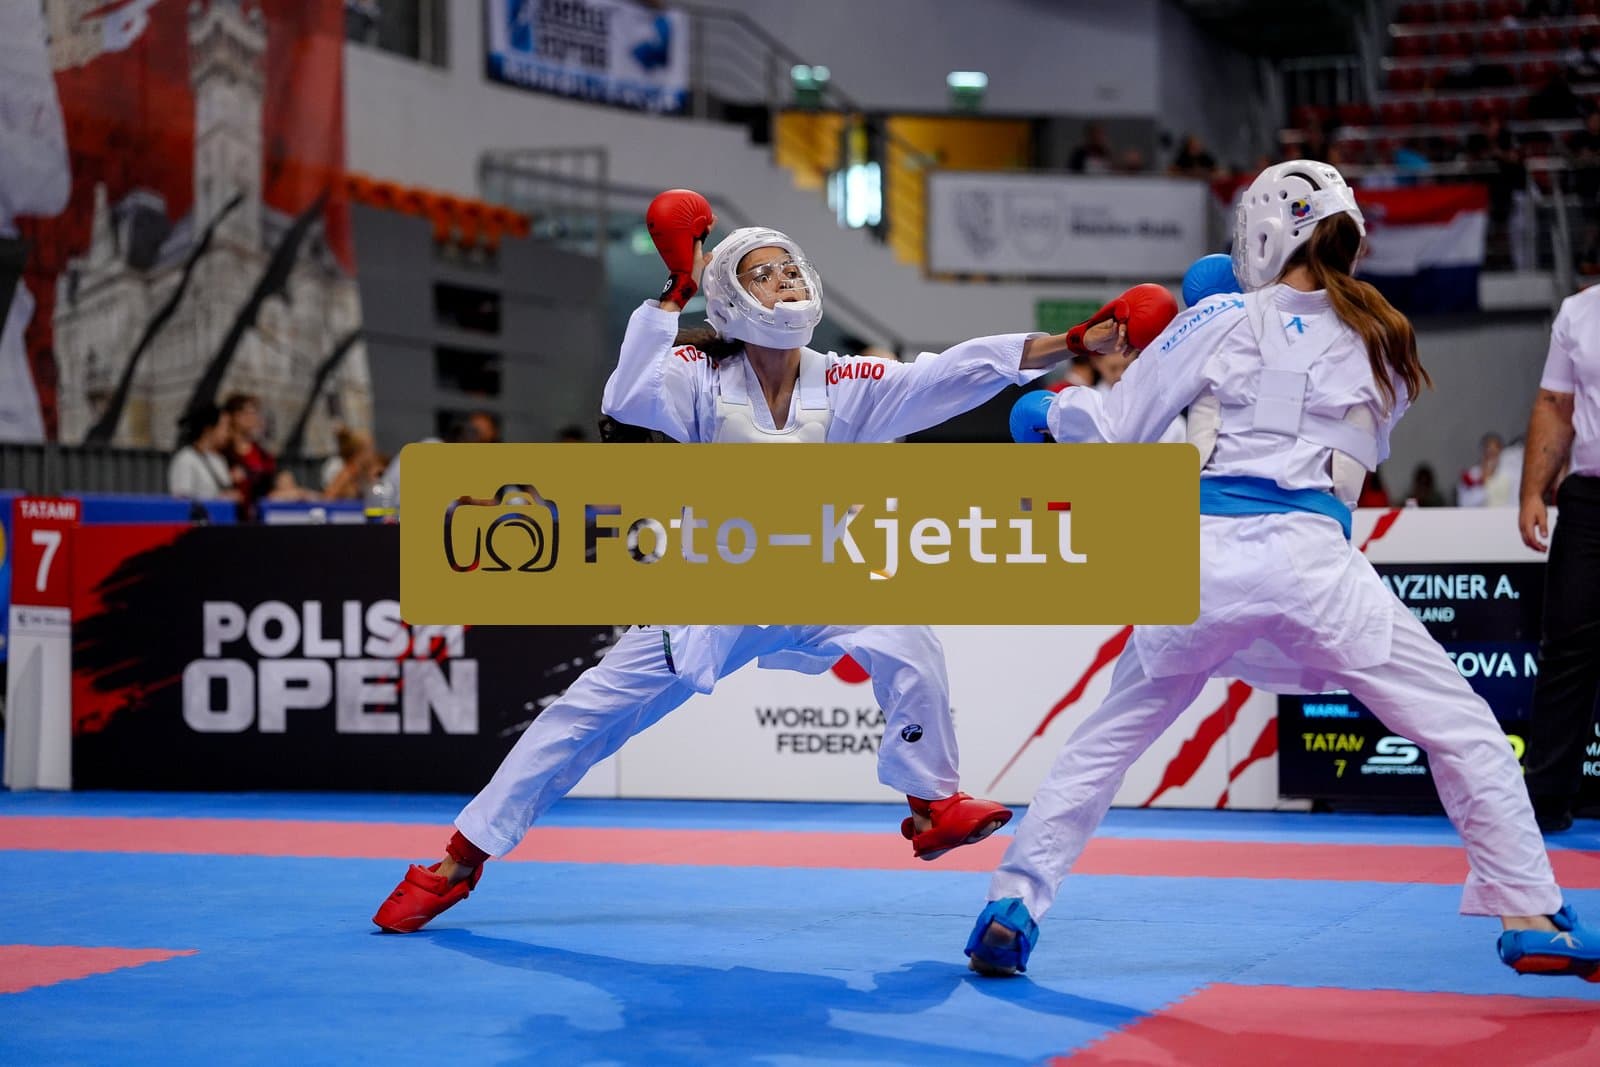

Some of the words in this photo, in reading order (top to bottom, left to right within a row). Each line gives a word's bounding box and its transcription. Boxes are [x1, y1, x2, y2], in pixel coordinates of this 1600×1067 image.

[20, 500, 77, 520] TATAMI
[31, 530, 62, 592] 7
[1493, 574, 1520, 600] A.
[202, 600, 465, 658] POLISH
[1447, 651, 1518, 678] OVA
[182, 658, 479, 734] OPEN
[755, 707, 850, 729] WORLD
[1334, 759, 1347, 779] 7
